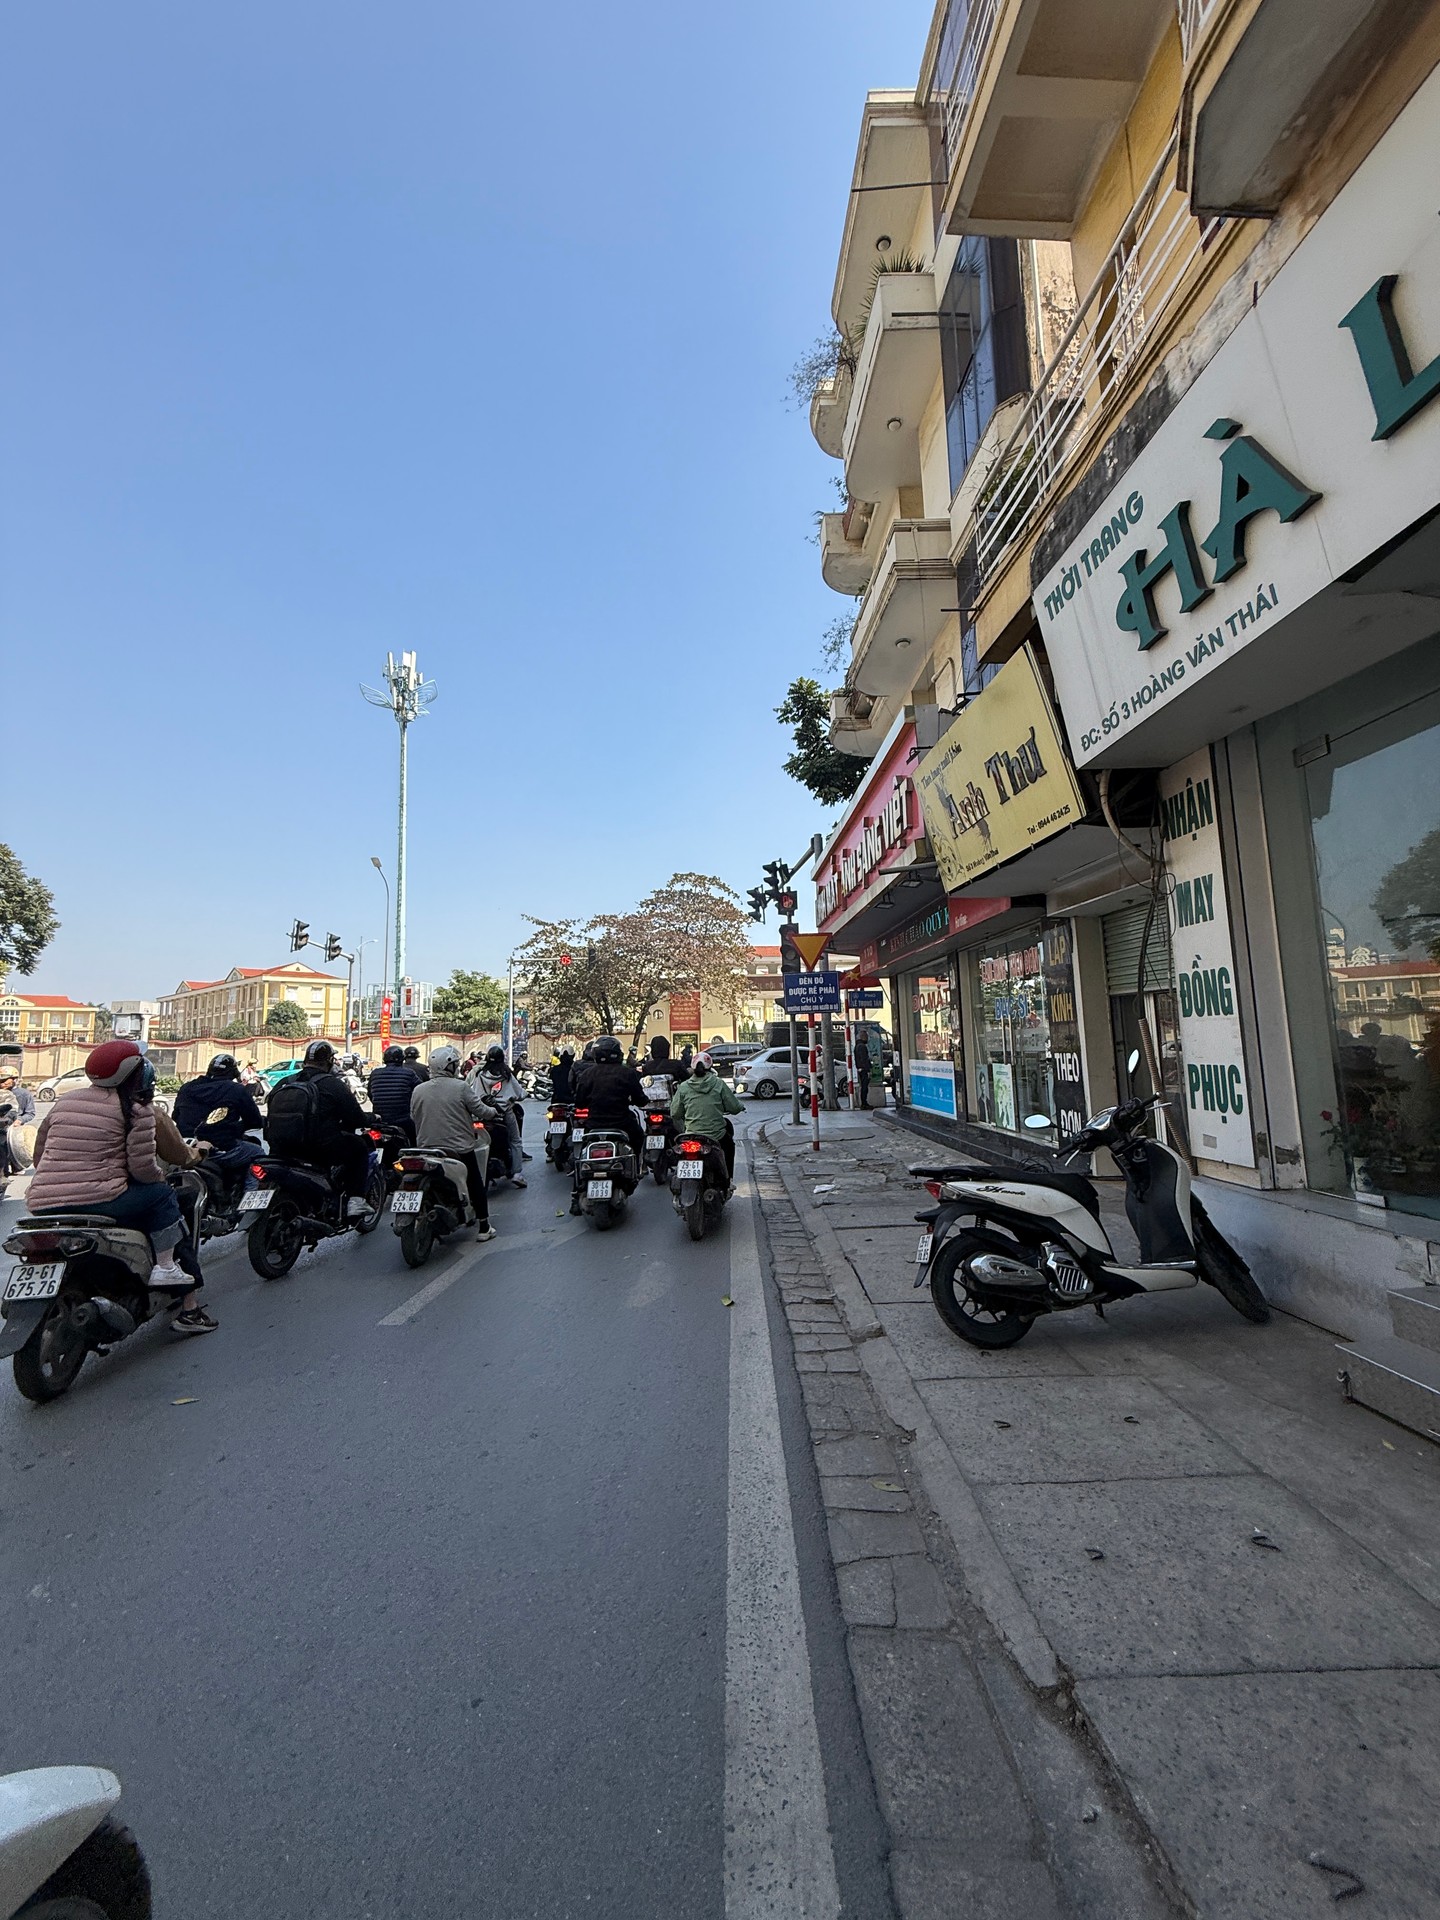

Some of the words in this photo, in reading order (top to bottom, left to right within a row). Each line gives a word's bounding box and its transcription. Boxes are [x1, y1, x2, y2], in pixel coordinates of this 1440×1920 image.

[1116, 417, 1324, 651] HÀ
[1044, 563, 1082, 621] THỜI
[1080, 490, 1144, 577] TRANG
[1080, 728, 1102, 751] ĐC:
[1102, 702, 1120, 734] SỐ
[1121, 702, 1130, 719] 3
[1131, 660, 1186, 713] HOÀNG
[1186, 627, 1224, 668] VĂN
[1224, 583, 1279, 637] THÁI
[948, 781, 990, 839] Anh
[984, 726, 1047, 805] Thư
[882, 775, 911, 850] VIỆT
[1162, 778, 1214, 842] NHẬN
[1176, 874, 1214, 928] MAY
[789, 988, 806, 996] ĐƯỢC
[819, 984, 835, 994] PHẢI
[799, 976, 812, 984] ĐÈN
[814, 974, 824, 984] ĐỎ
[1179, 954, 1234, 1018] ĐỒNG
[800, 996, 816, 1004] CHÚ
[1050, 988, 1073, 1022] KÍNH
[1054, 1052, 1079, 1083] THEO
[1188, 1064, 1244, 1124] PHỤC
[1060, 1108, 1082, 1138] ĐƠN
[678, 1169, 700, 1178] 756.69
[681, 1161, 700, 1169] 29-G1
[392, 1202, 418, 1212] 524.82
[7, 1280, 56, 1298] 675.76
[17, 1265, 56, 1281] 29-G1
